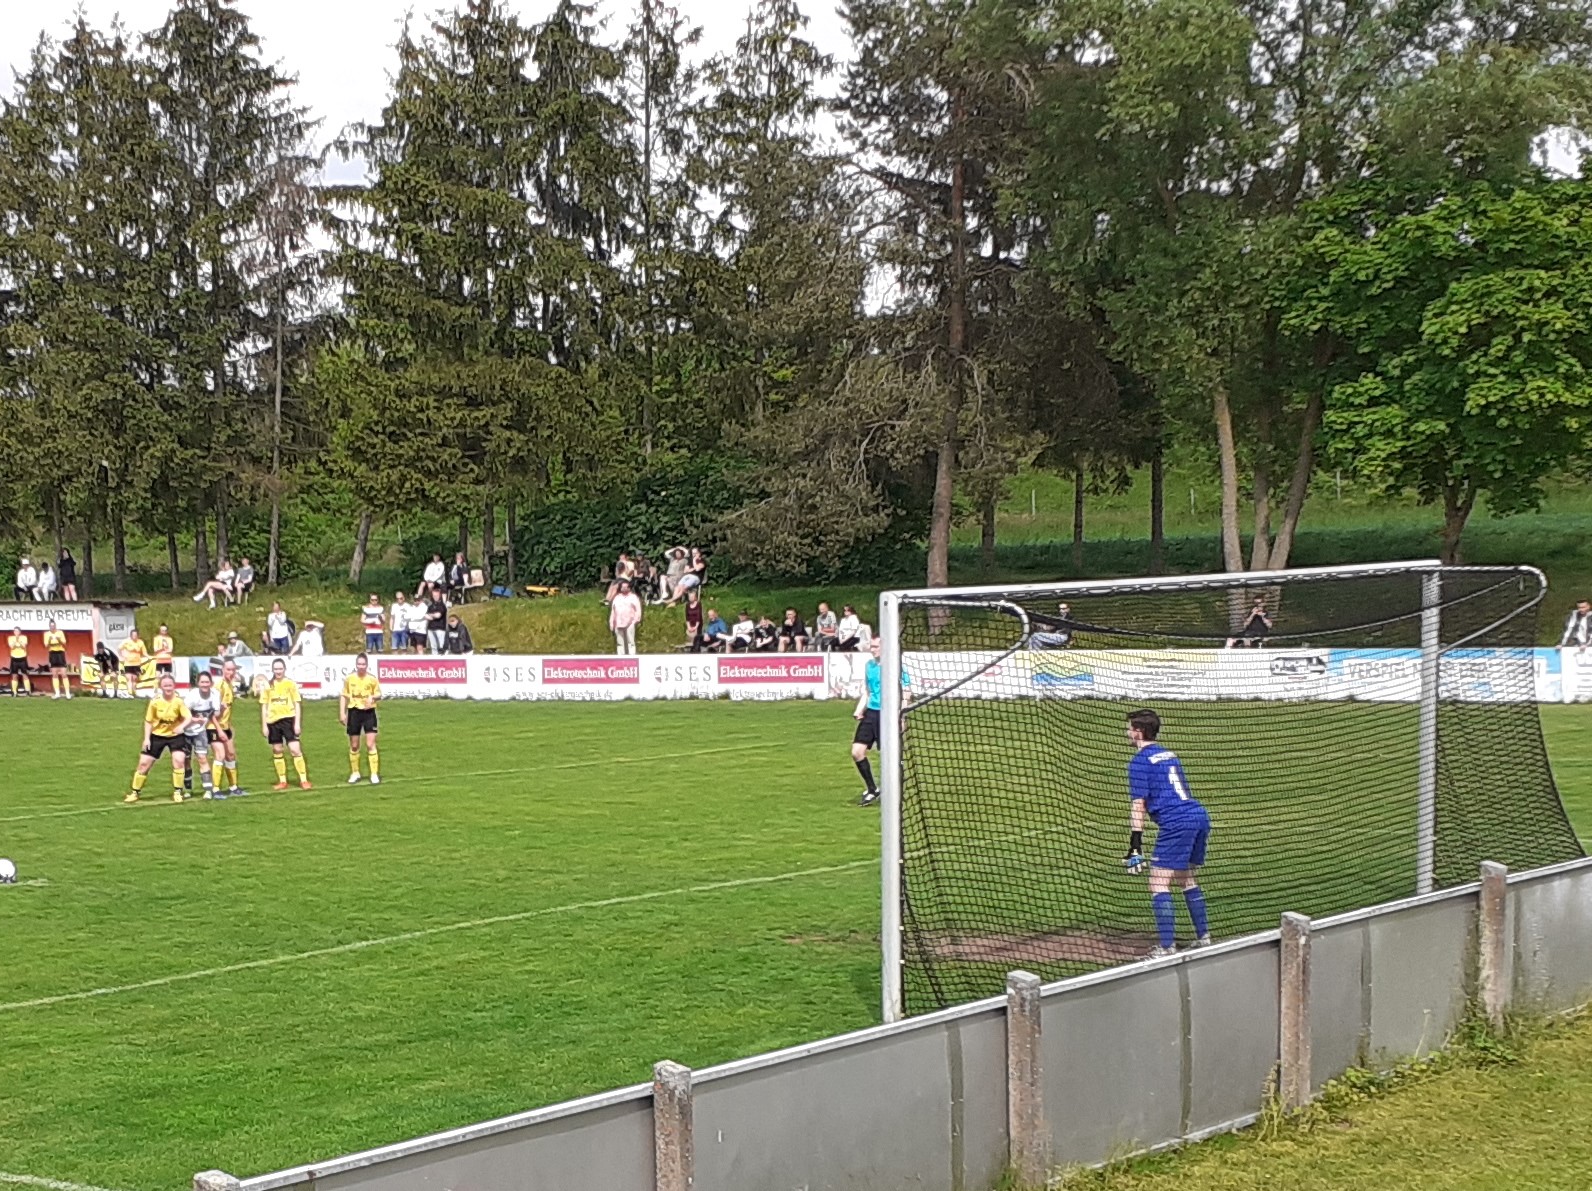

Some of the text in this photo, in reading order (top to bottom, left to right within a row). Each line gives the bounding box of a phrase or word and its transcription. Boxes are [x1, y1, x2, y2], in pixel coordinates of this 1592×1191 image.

[36, 608, 92, 622] BAYREUTH
[379, 666, 437, 679] Elektrotechnik
[438, 667, 466, 679] GmbH
[544, 666, 607, 679] Elektrotechnik
[608, 666, 638, 679] GmbH
[719, 664, 788, 678] Elektrotechnik
[790, 664, 823, 677] GmbH
[1168, 766, 1189, 801] 1
